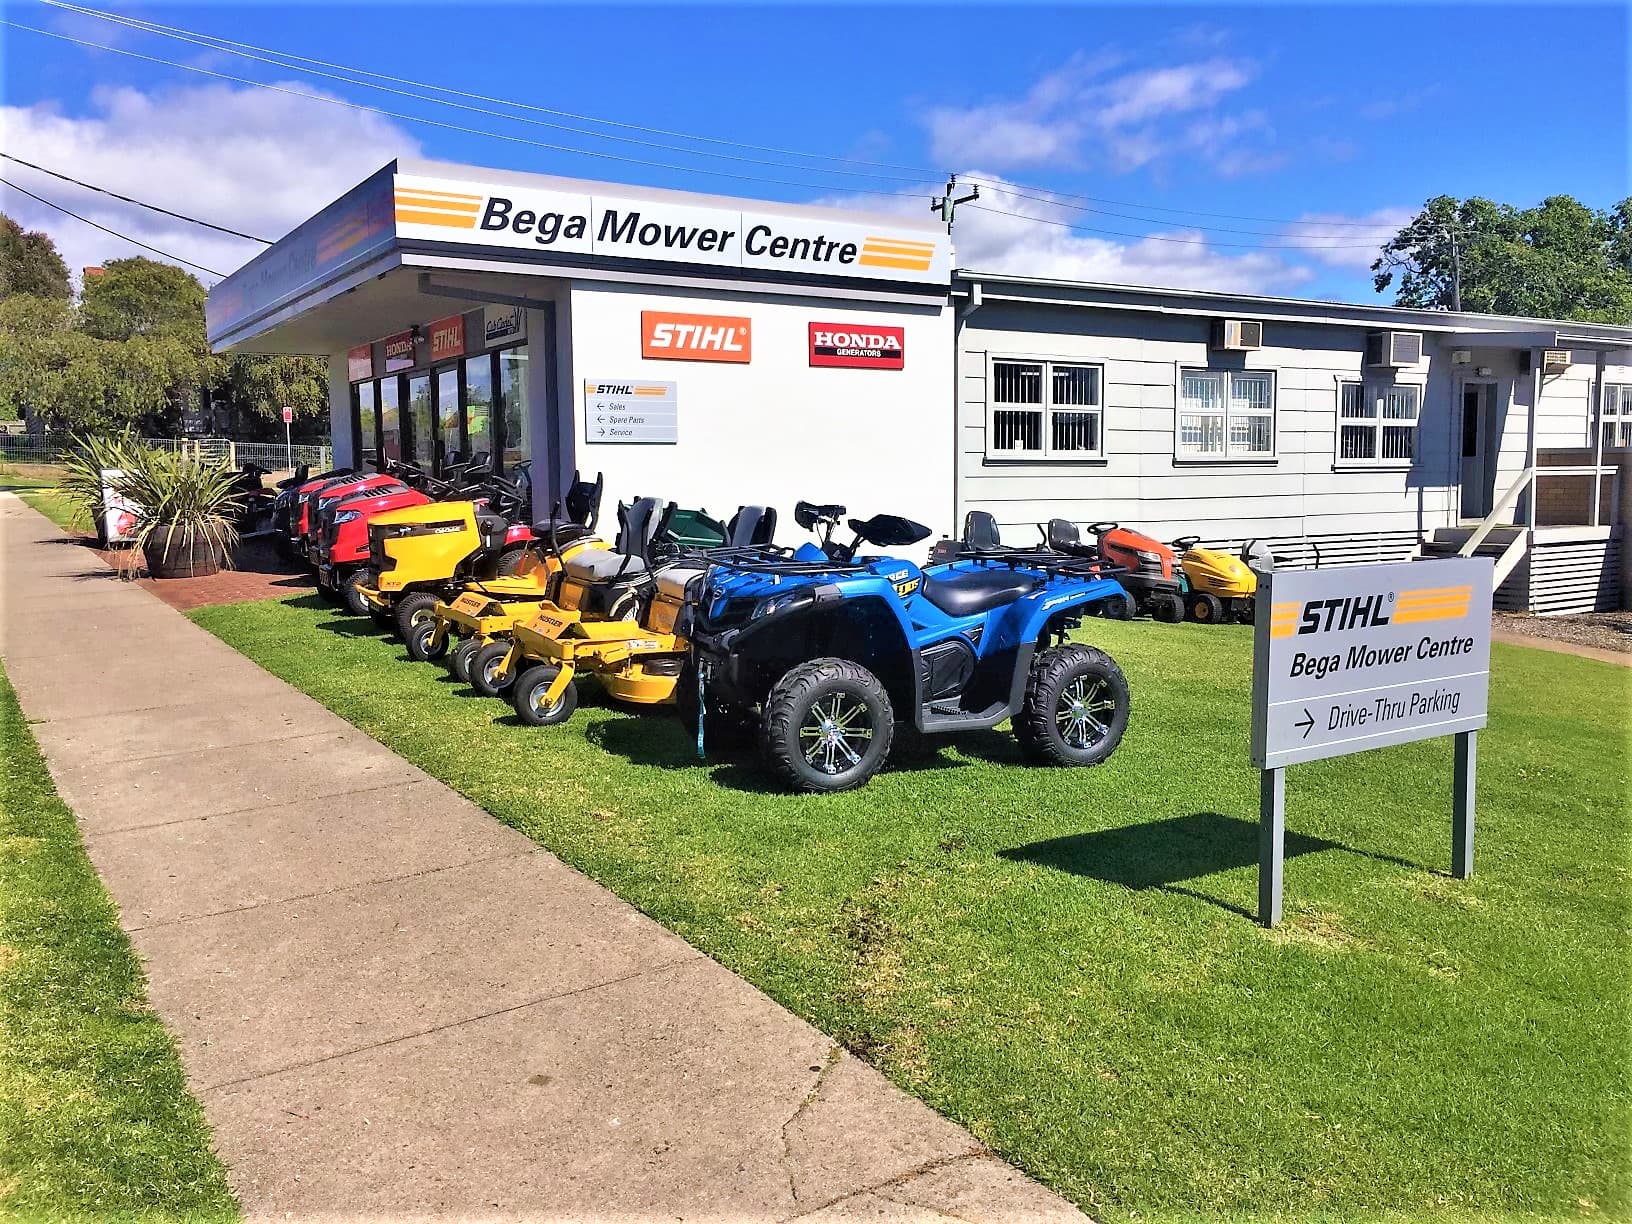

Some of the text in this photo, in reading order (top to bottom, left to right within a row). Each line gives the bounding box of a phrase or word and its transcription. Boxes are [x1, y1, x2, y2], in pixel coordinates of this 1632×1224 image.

[480, 197, 857, 264] Bega Mower Centre
[433, 327, 462, 352] STIHL
[814, 331, 902, 350] HONDA
[386, 340, 412, 357] HONDA
[837, 349, 881, 358] GENERATORS
[597, 385, 633, 394] STIHL
[609, 416, 628, 424] Spare
[460, 598, 481, 608] HUSTLER
[538, 614, 563, 628] HUSTLER
[1290, 635, 1474, 680] Bega Mower Centre
[1327, 689, 1460, 731] Drive-Thru Parking
